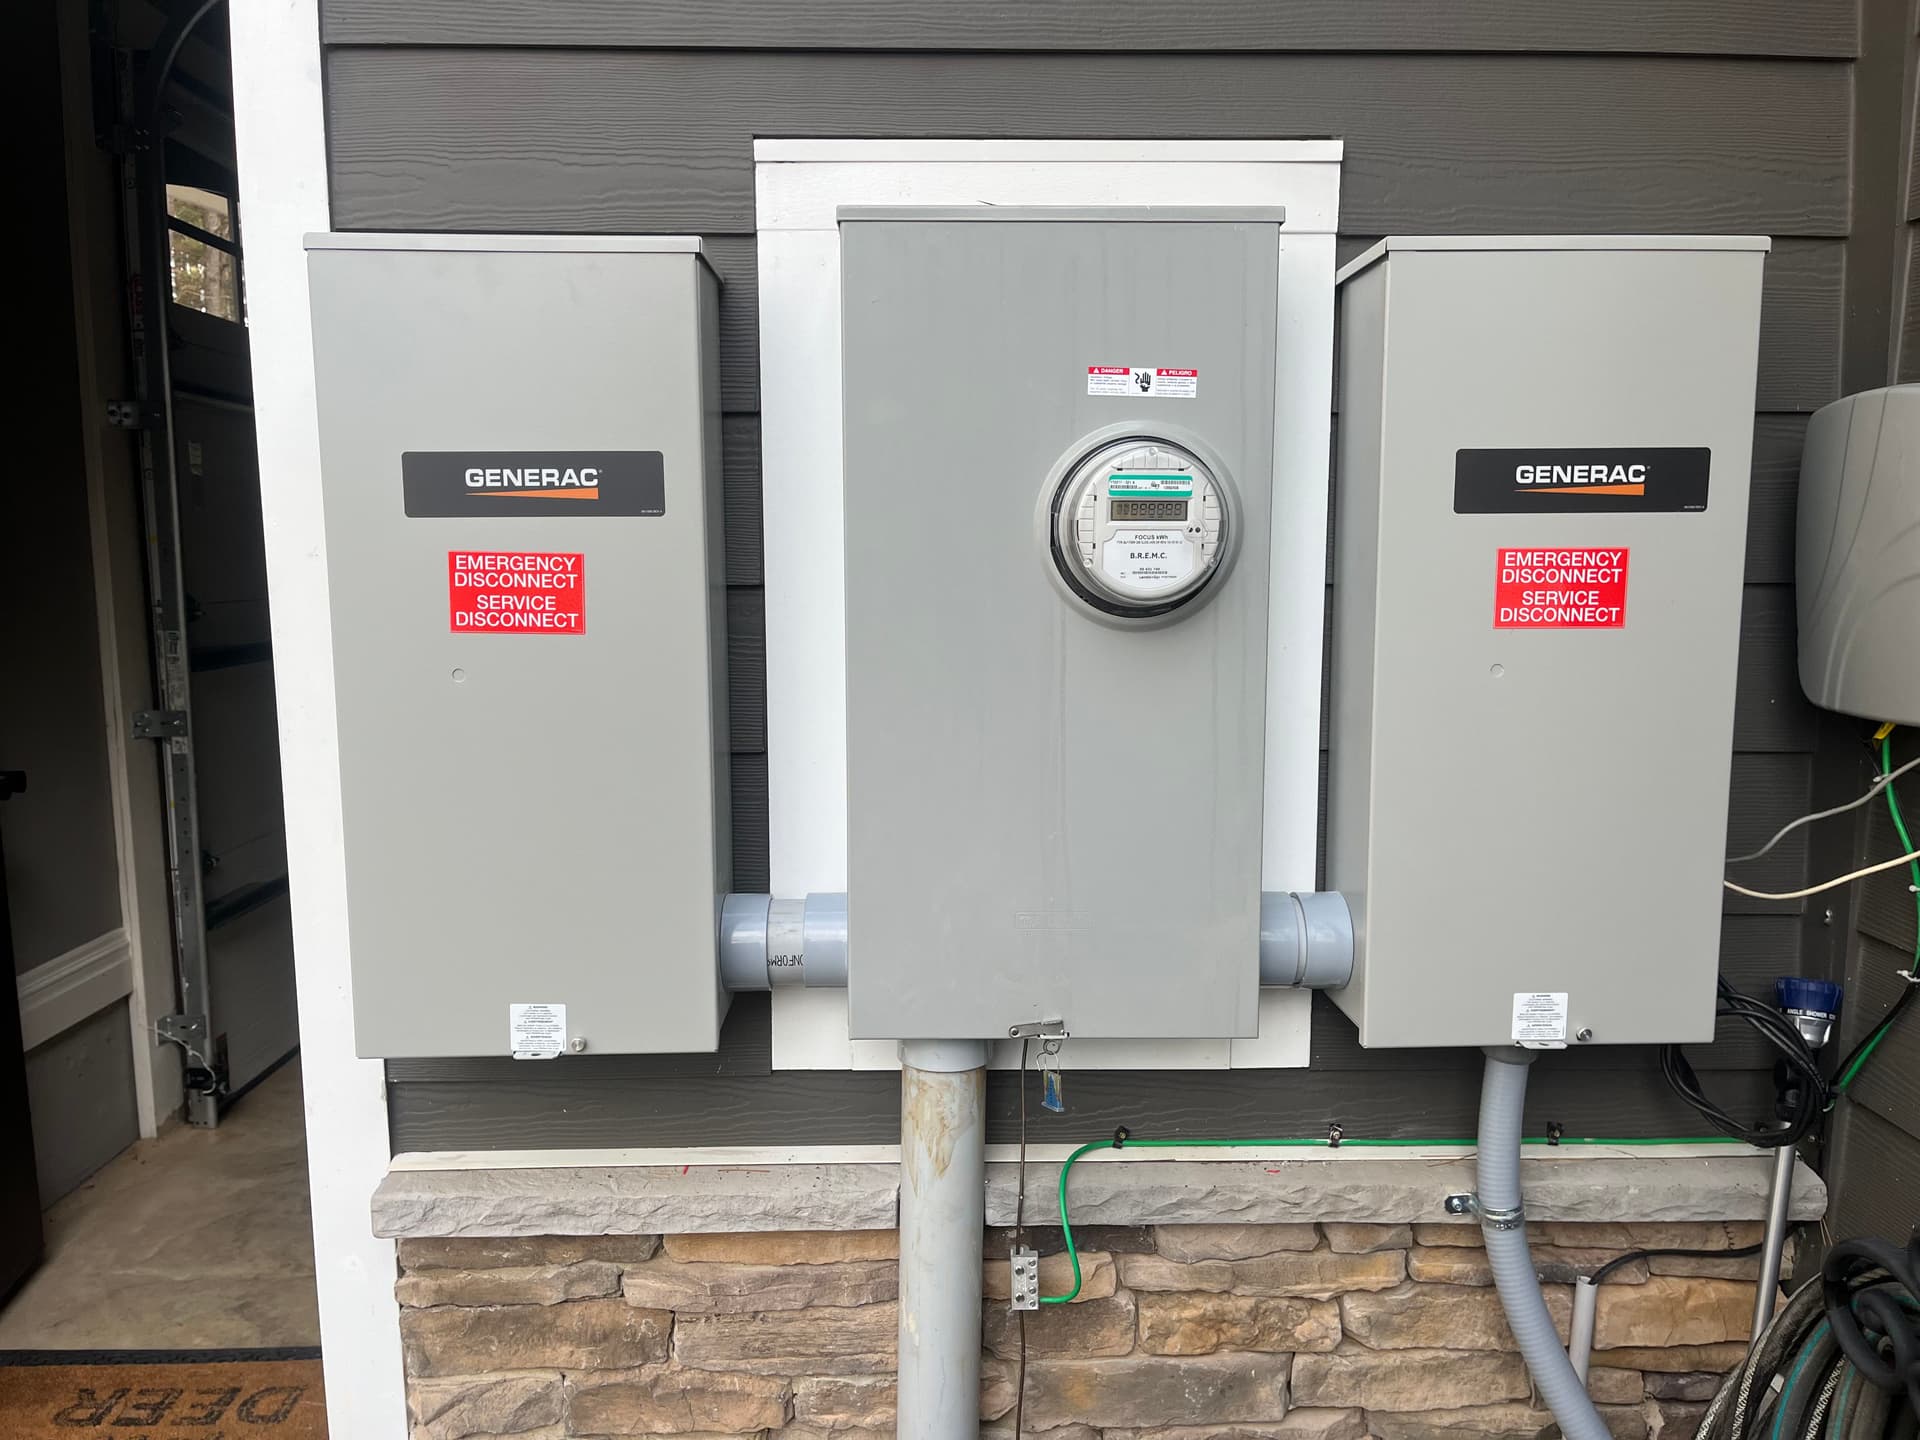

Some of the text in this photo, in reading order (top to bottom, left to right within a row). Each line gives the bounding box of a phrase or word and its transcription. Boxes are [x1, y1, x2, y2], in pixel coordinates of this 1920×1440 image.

[465, 468, 599, 487] GENERAC
[1515, 464, 1646, 484] GENERAC
[455, 555, 576, 571] EMERGENCY
[1504, 551, 1622, 567] EMERGENCY
[454, 572, 578, 589] DISCONNECT
[1502, 568, 1623, 584] DISCONNECT
[476, 594, 557, 611] SERVICE
[1521, 590, 1600, 606] SERVICE
[455, 611, 579, 628] DISCONNECT
[1499, 607, 1620, 623] DISCONNECT
[53, 1386, 308, 1426] DEER
